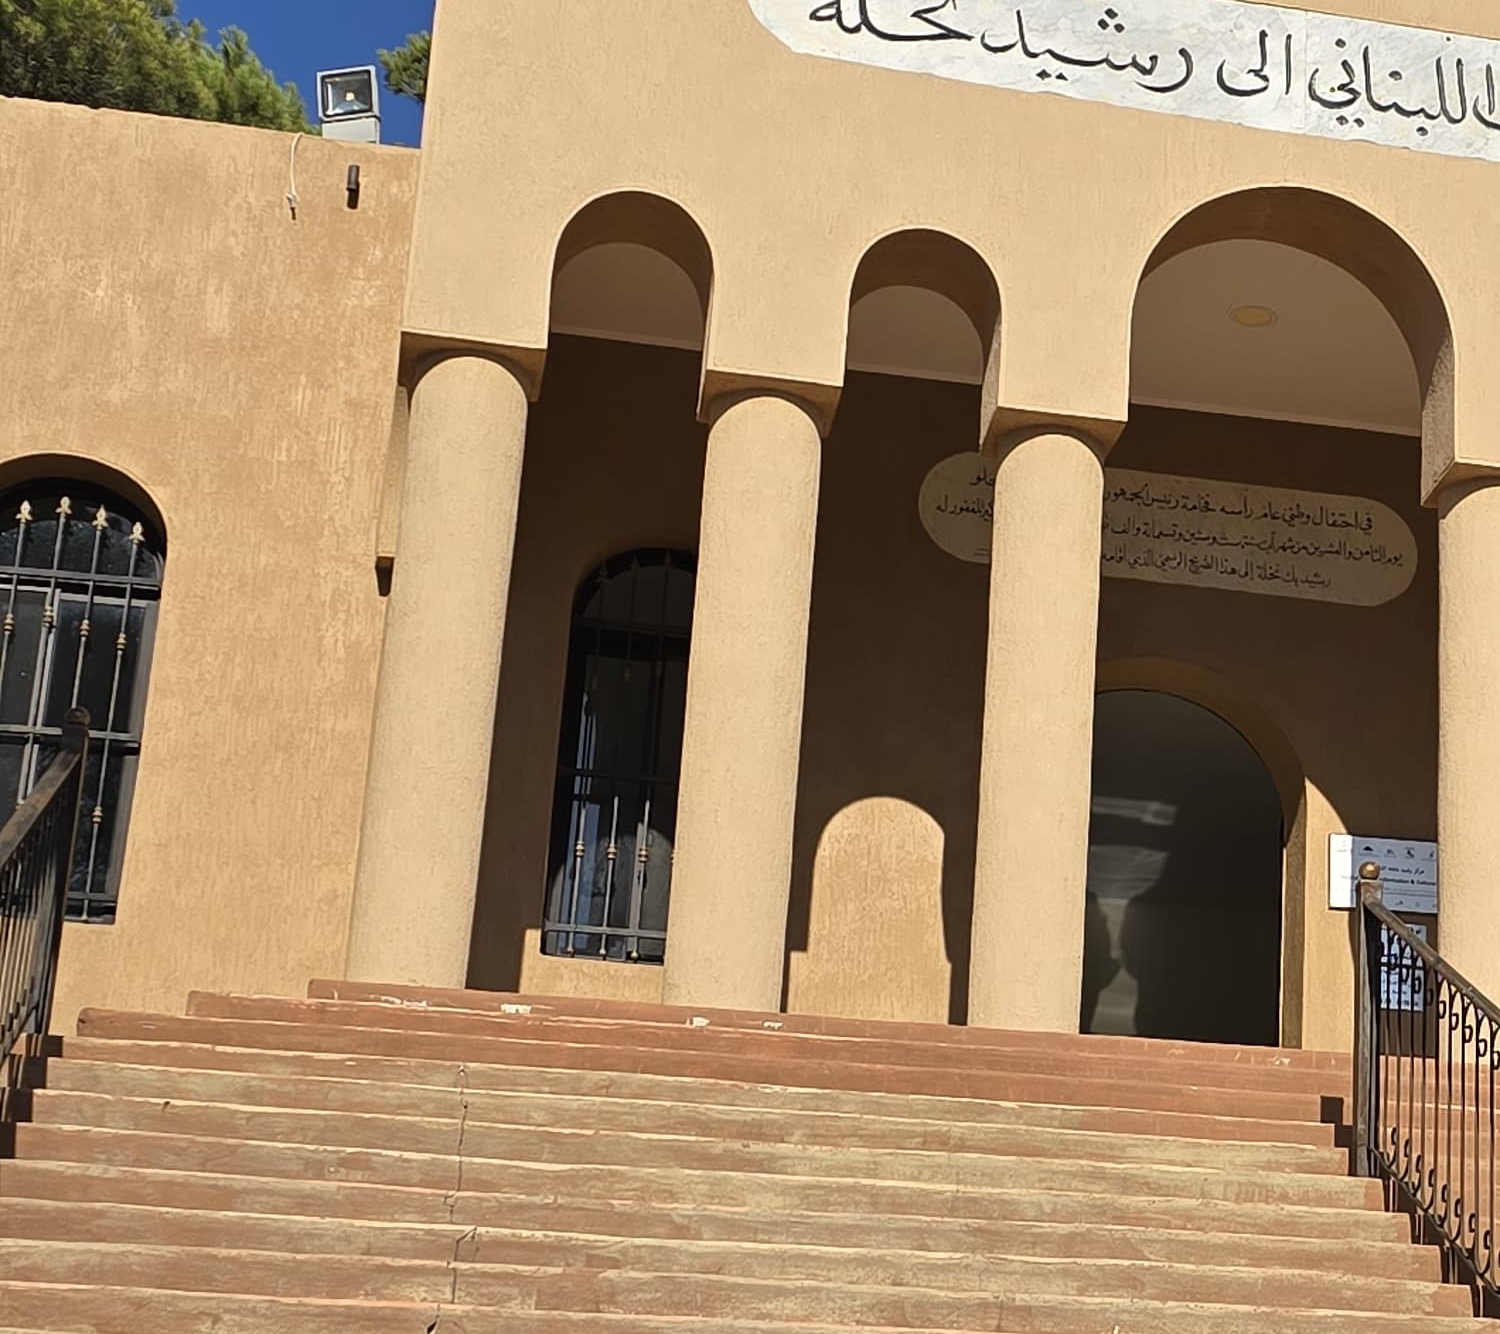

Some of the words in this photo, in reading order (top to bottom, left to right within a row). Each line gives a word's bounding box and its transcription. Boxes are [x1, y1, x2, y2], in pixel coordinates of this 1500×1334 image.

[980, 8, 1193, 94] رشيد
[1217, 29, 1292, 97] الى
[1308, 38, 1495, 136] اللبناني
[1358, 512, 1374, 535] في
